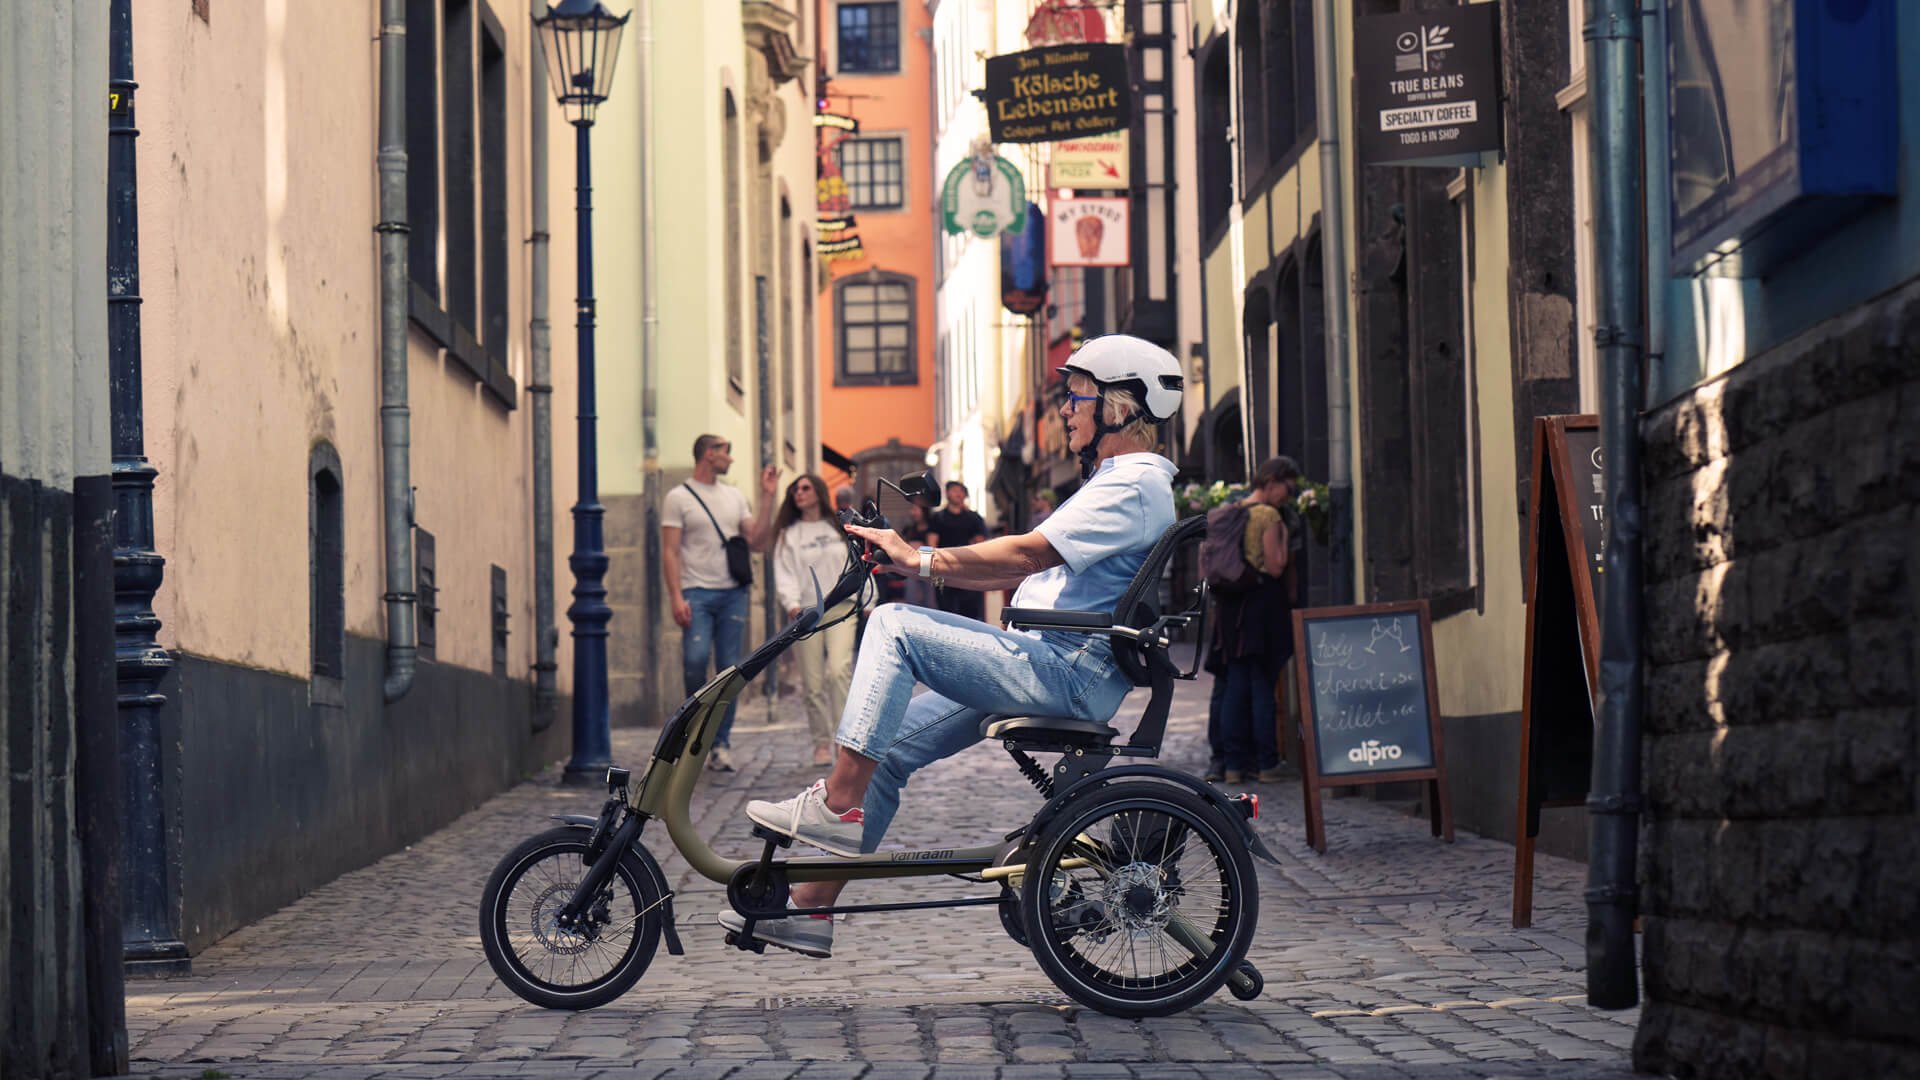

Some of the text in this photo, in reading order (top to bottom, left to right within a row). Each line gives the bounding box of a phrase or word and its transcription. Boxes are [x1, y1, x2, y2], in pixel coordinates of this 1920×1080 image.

[1011, 69, 1101, 98] Kölsche
[1390, 74, 1464, 94] TRUE BEANS
[997, 87, 1119, 121] Lebensart
[1385, 105, 1472, 127] SPECIALTY COFFEE
[1400, 132, 1420, 144] TOGO
[1429, 130, 1437, 141] IN
[1438, 128, 1460, 140] SHOP
[1348, 740, 1402, 766] alpro
[891, 850, 954, 862] vanraam
